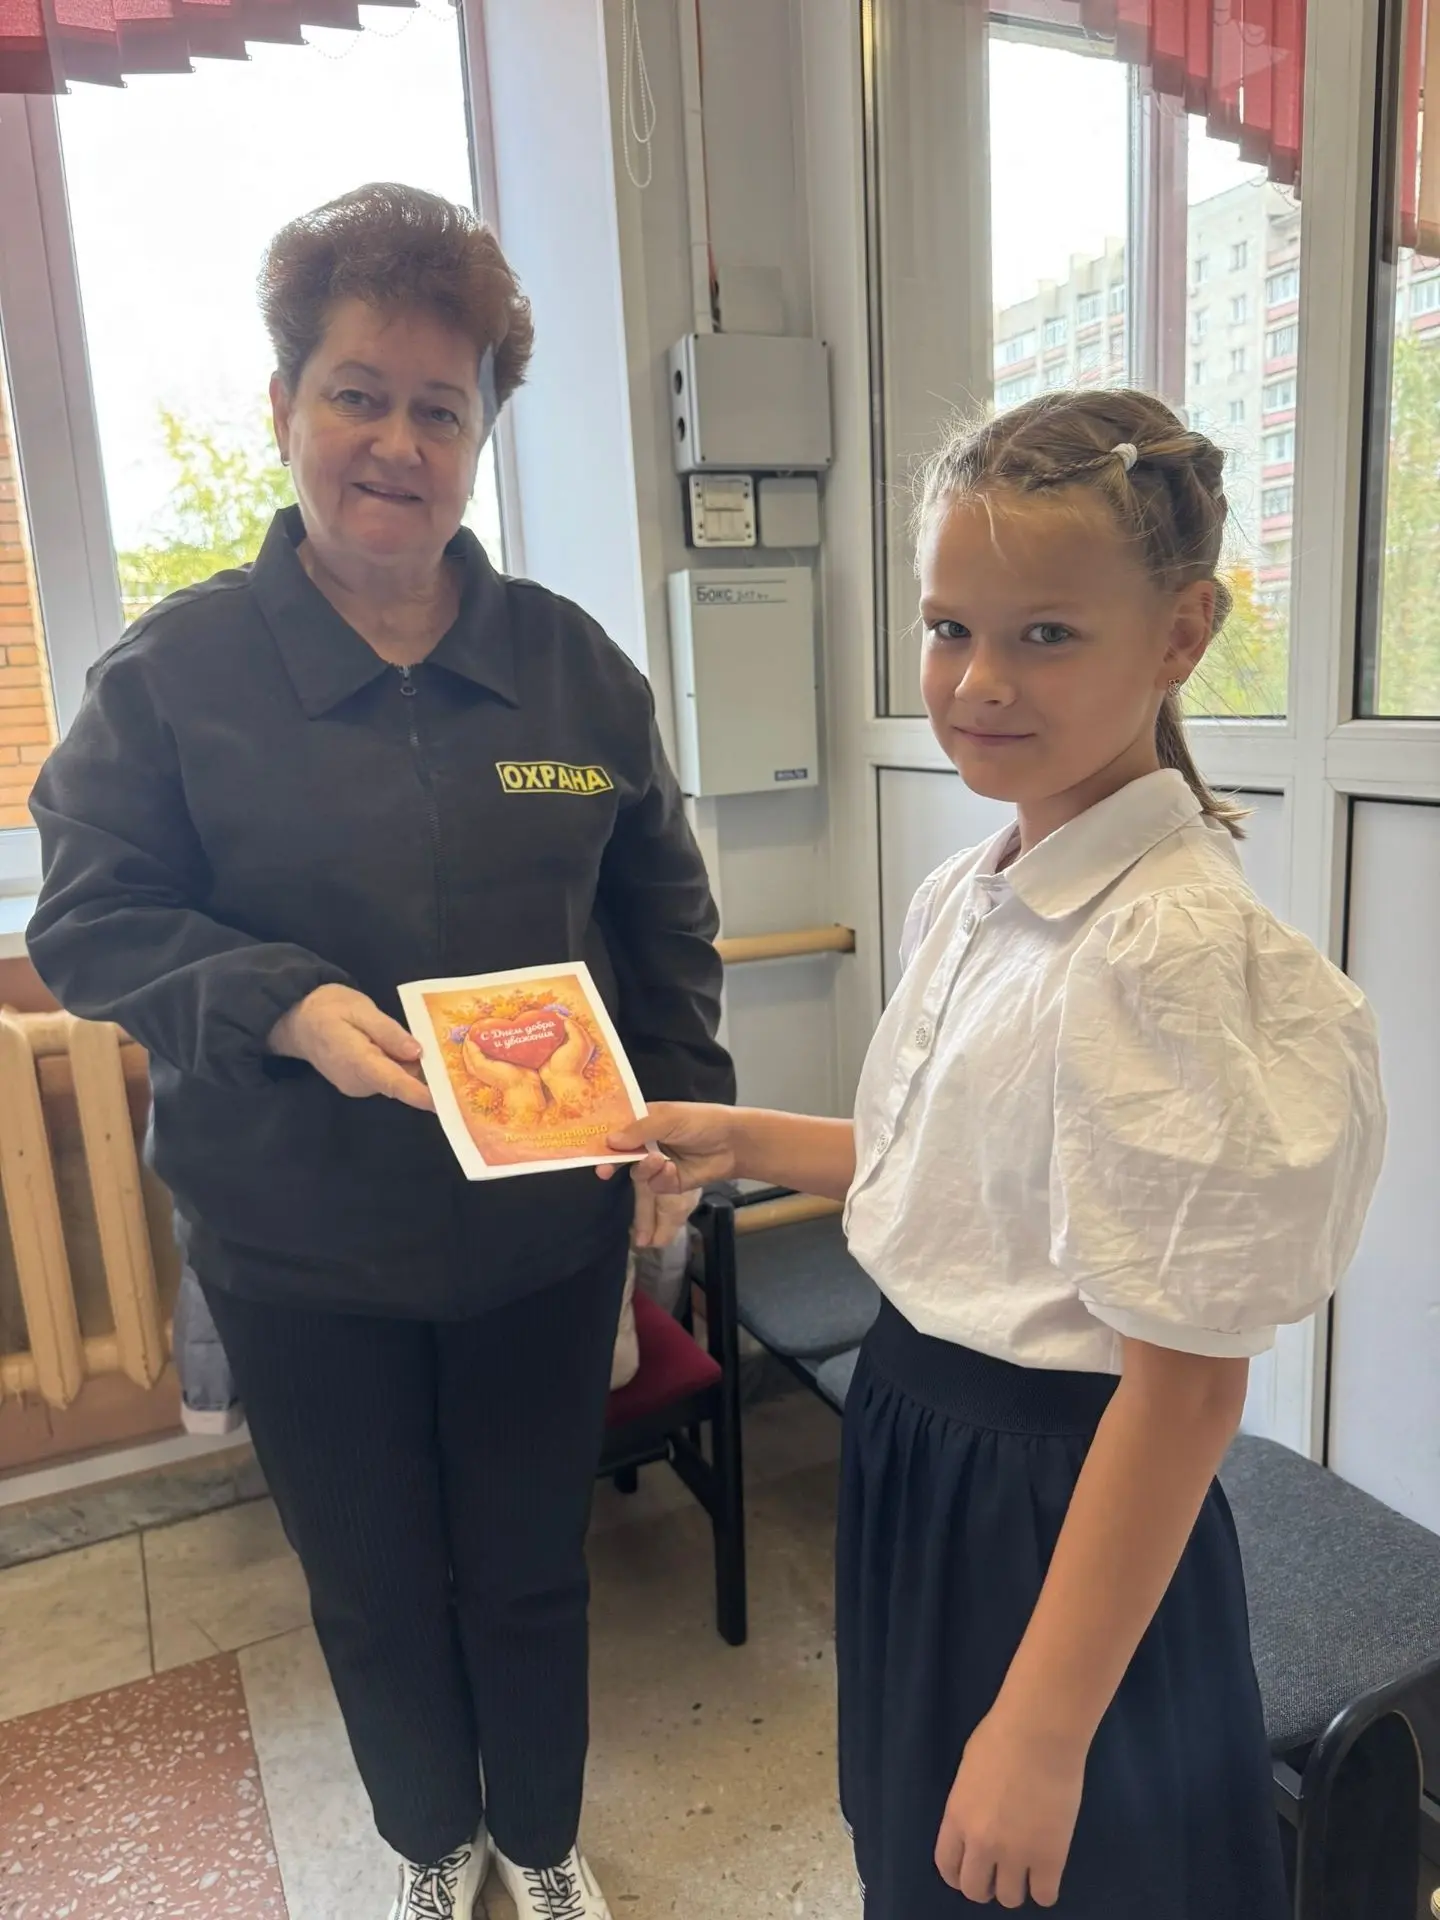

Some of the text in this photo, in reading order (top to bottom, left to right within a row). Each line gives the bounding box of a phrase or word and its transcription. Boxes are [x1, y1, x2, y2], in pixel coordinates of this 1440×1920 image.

[503, 765, 607, 791] ОХРАНА
[480, 1031, 489, 1041] С
[525, 1020, 556, 1034] добра
[494, 1030, 554, 1049] и уважения
